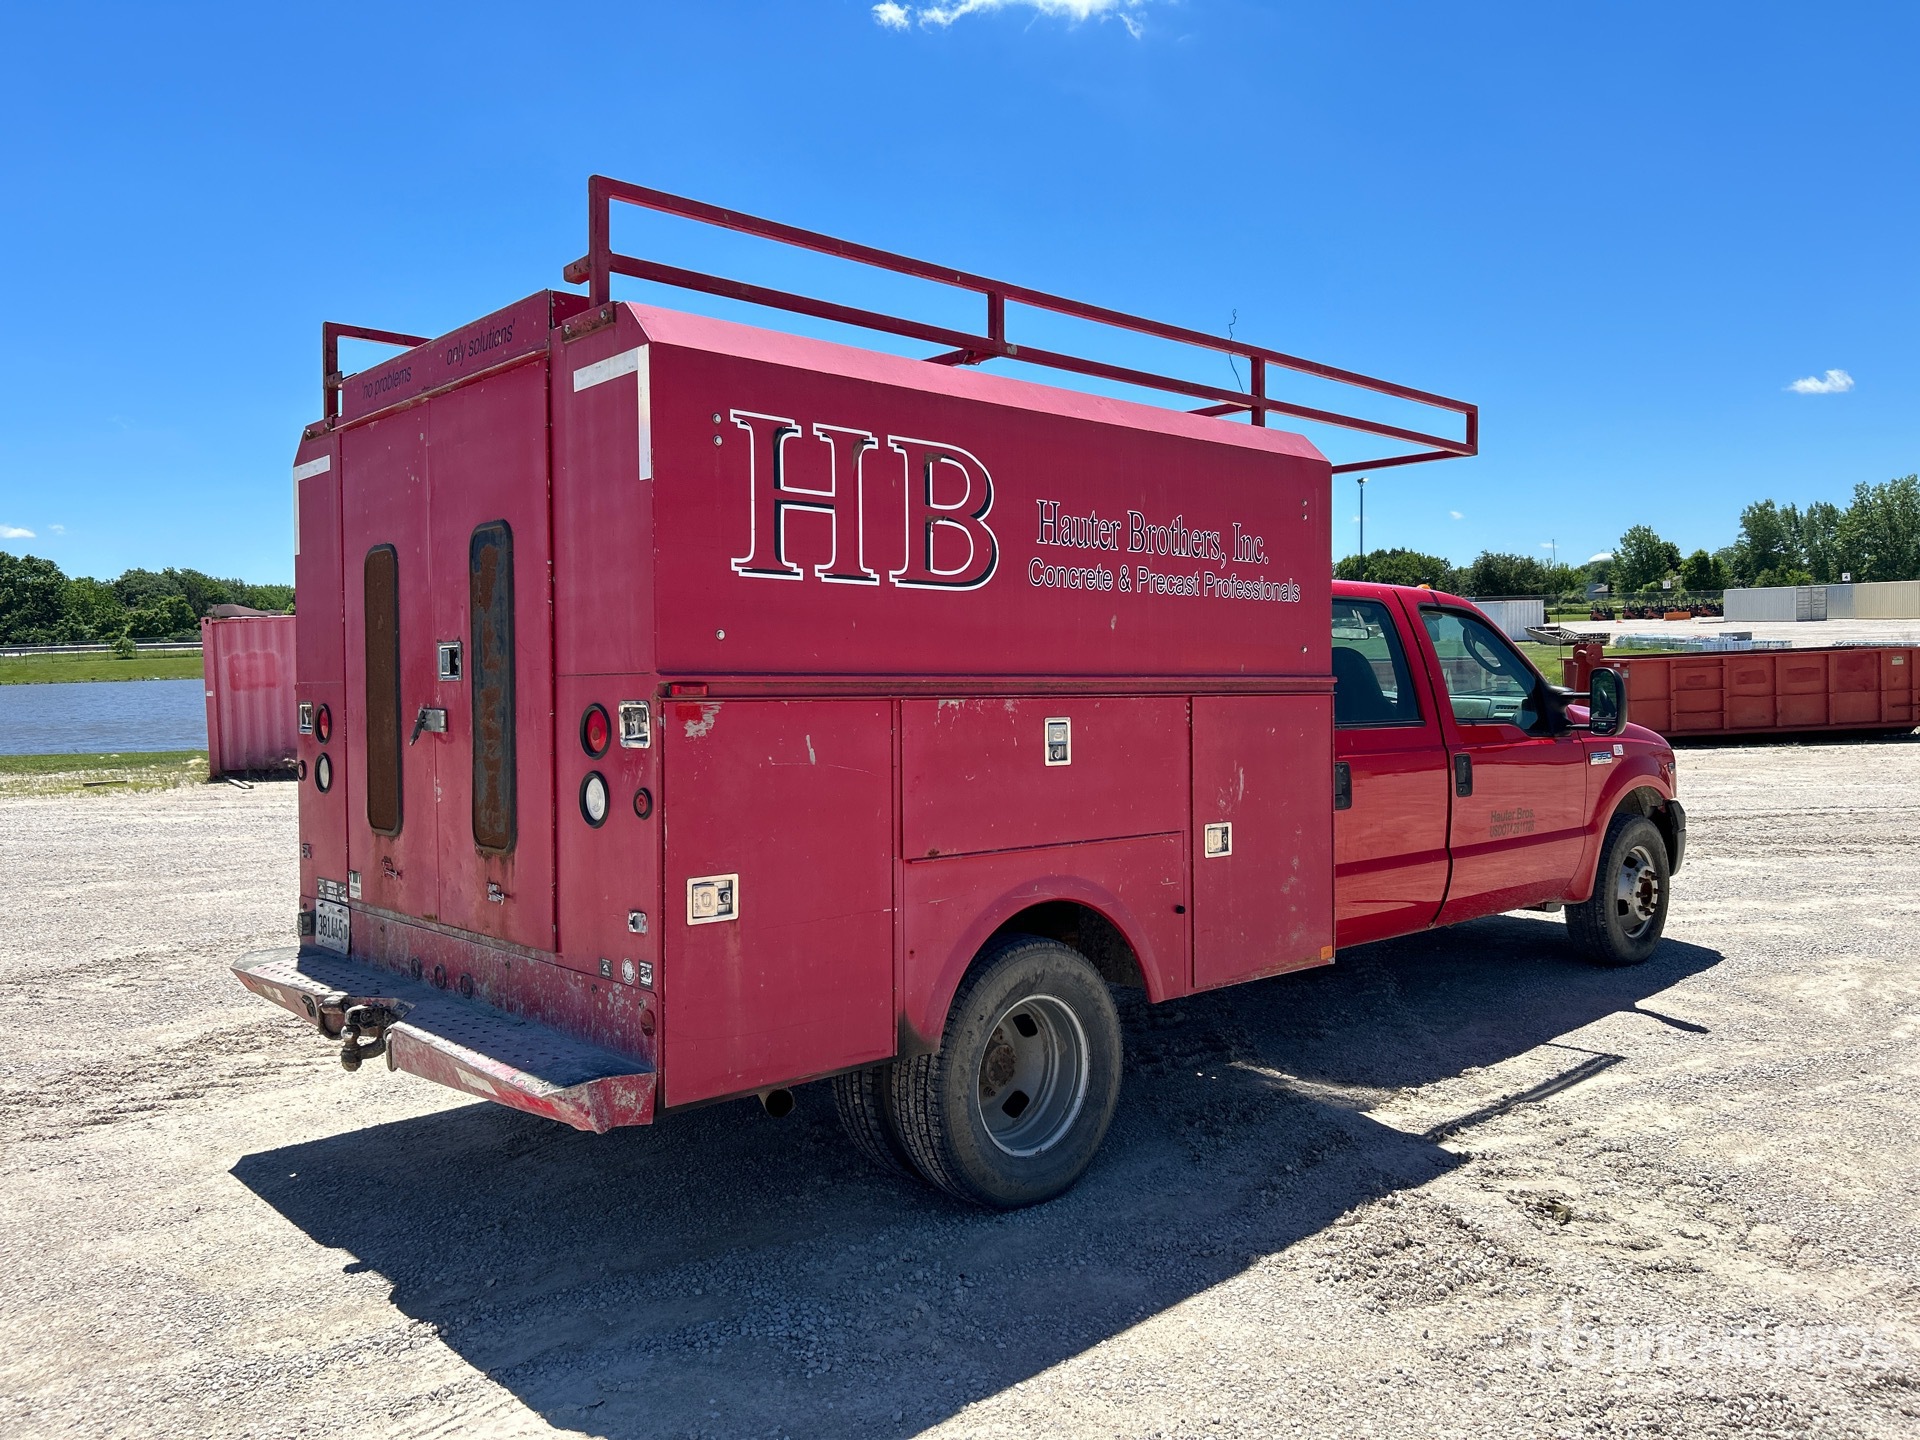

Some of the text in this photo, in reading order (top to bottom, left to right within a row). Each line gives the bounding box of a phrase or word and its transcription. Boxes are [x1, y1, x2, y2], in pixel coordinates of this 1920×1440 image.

[446, 346, 466, 367] only
[374, 366, 412, 398] problems
[730, 408, 1000, 592] HB
[1036, 499, 1270, 569] Hauter Brothers, Inc.
[1028, 557, 1301, 603] Concrete & Precast Professionals
